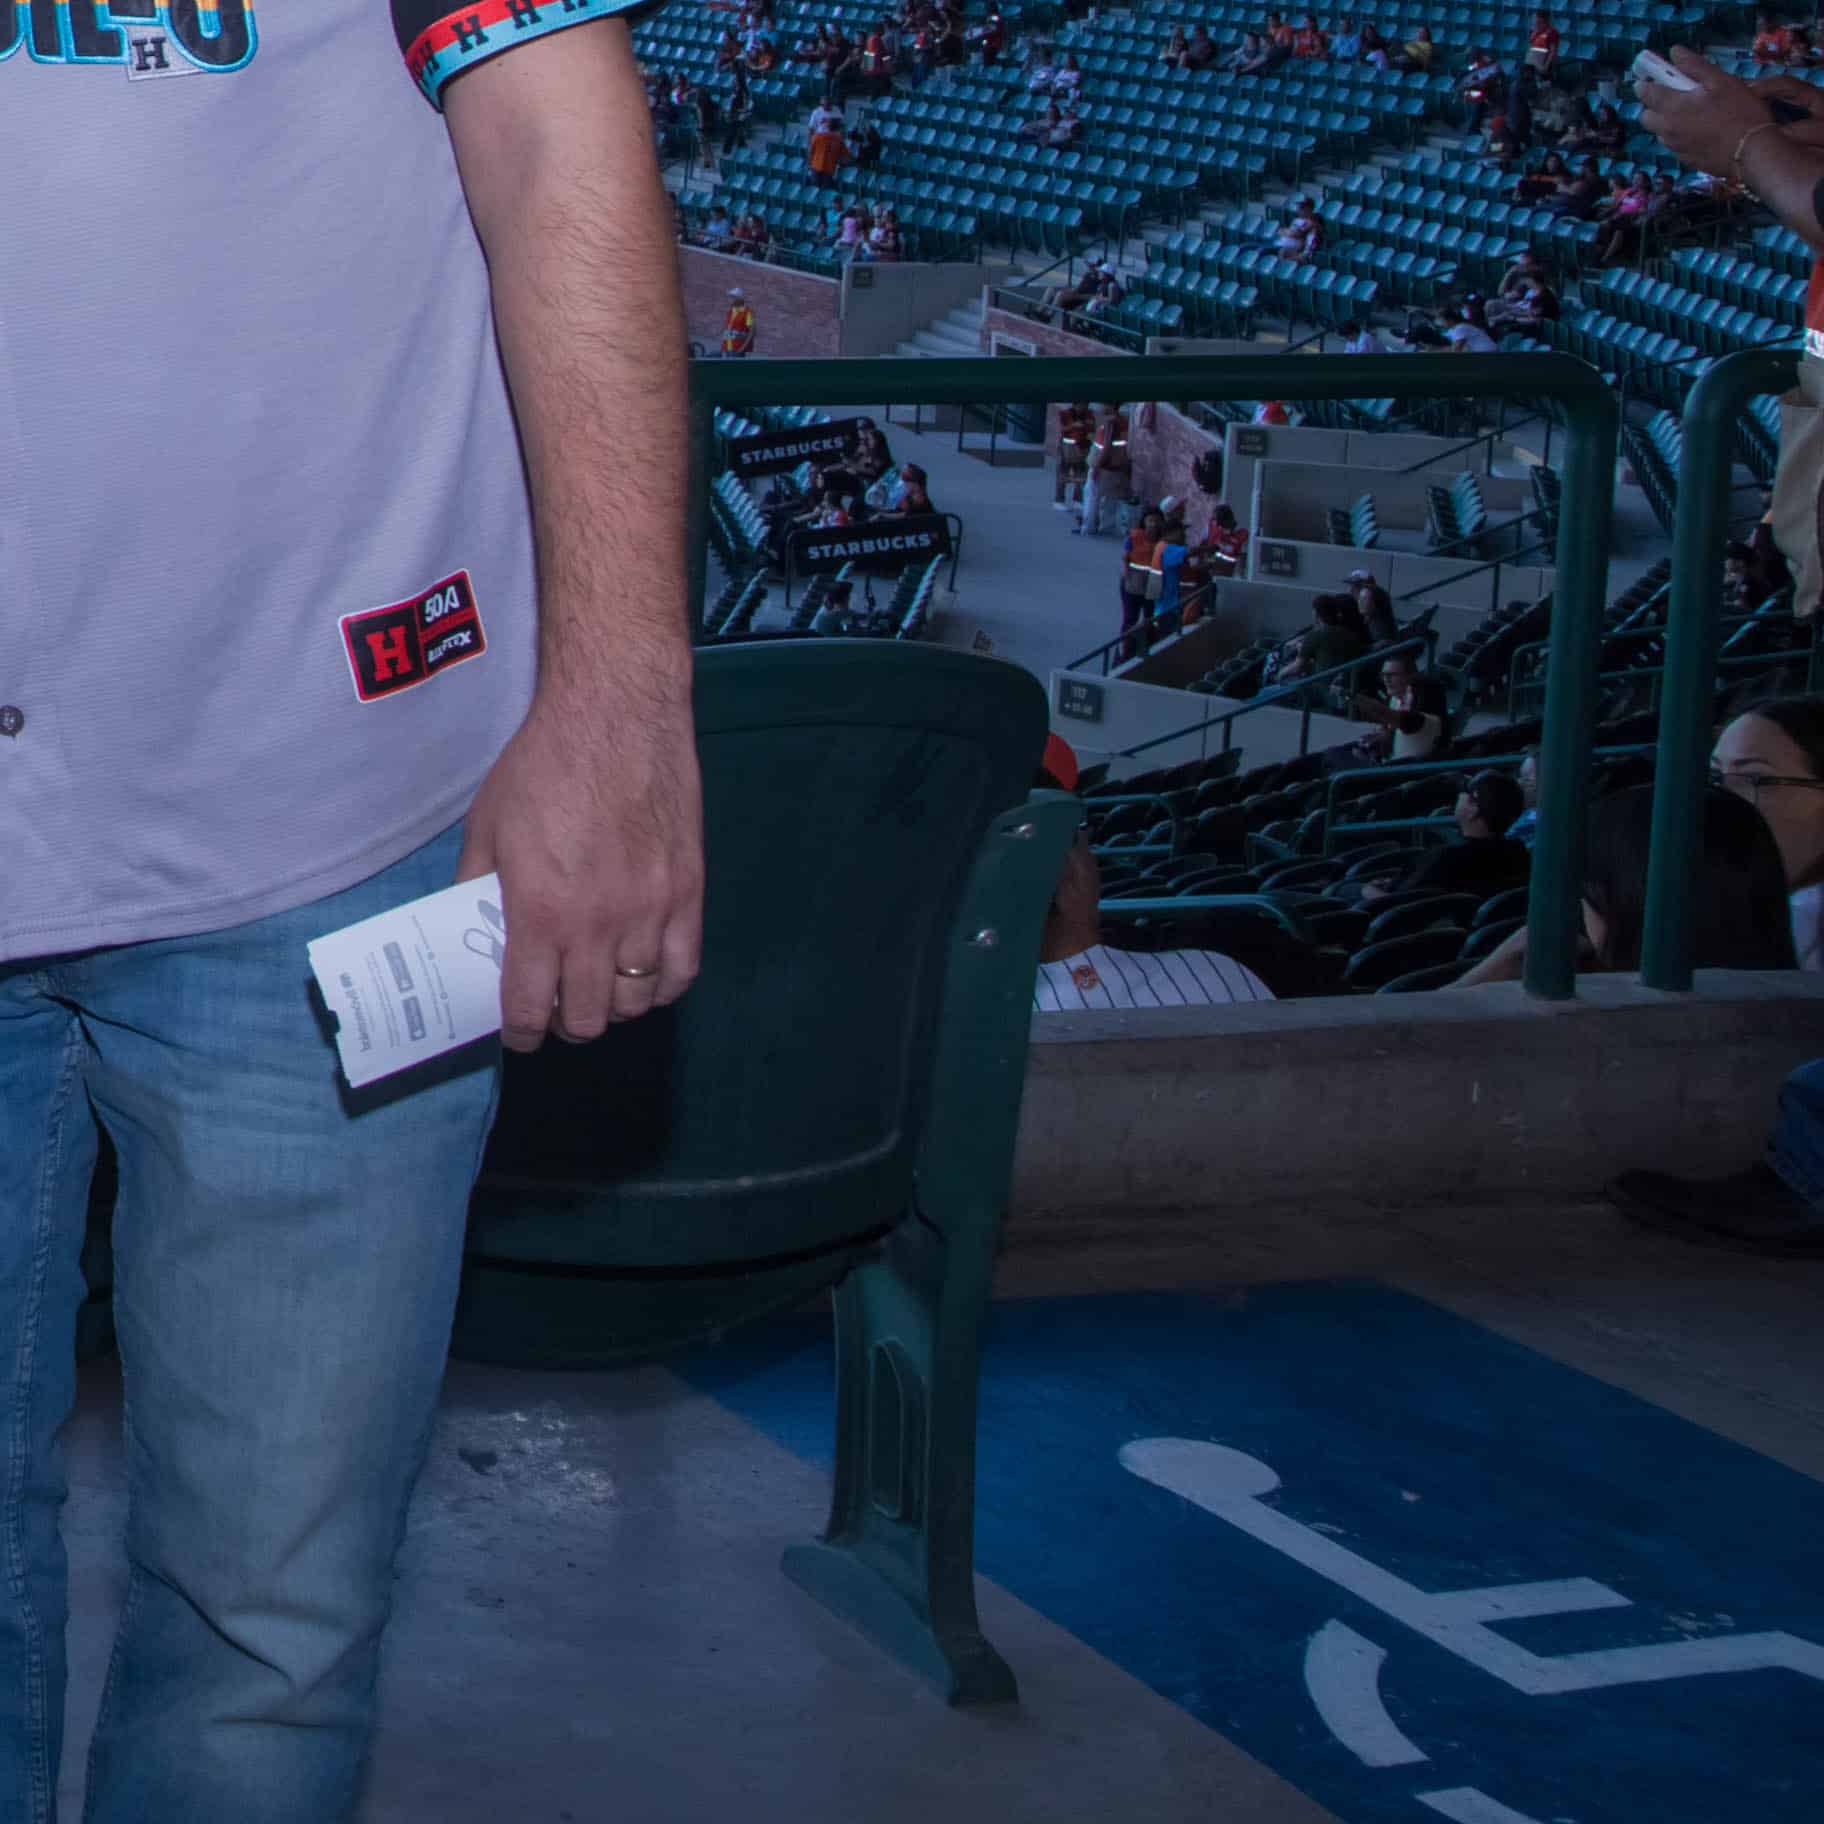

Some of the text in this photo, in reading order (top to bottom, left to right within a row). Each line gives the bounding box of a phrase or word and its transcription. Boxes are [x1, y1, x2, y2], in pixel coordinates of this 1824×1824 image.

[452, 15, 490, 54] H
[130, 37, 171, 71] H
[740, 435, 845, 465] STARBUCKS
[806, 532, 932, 560] STARBUCKS
[366, 624, 413, 682] H
